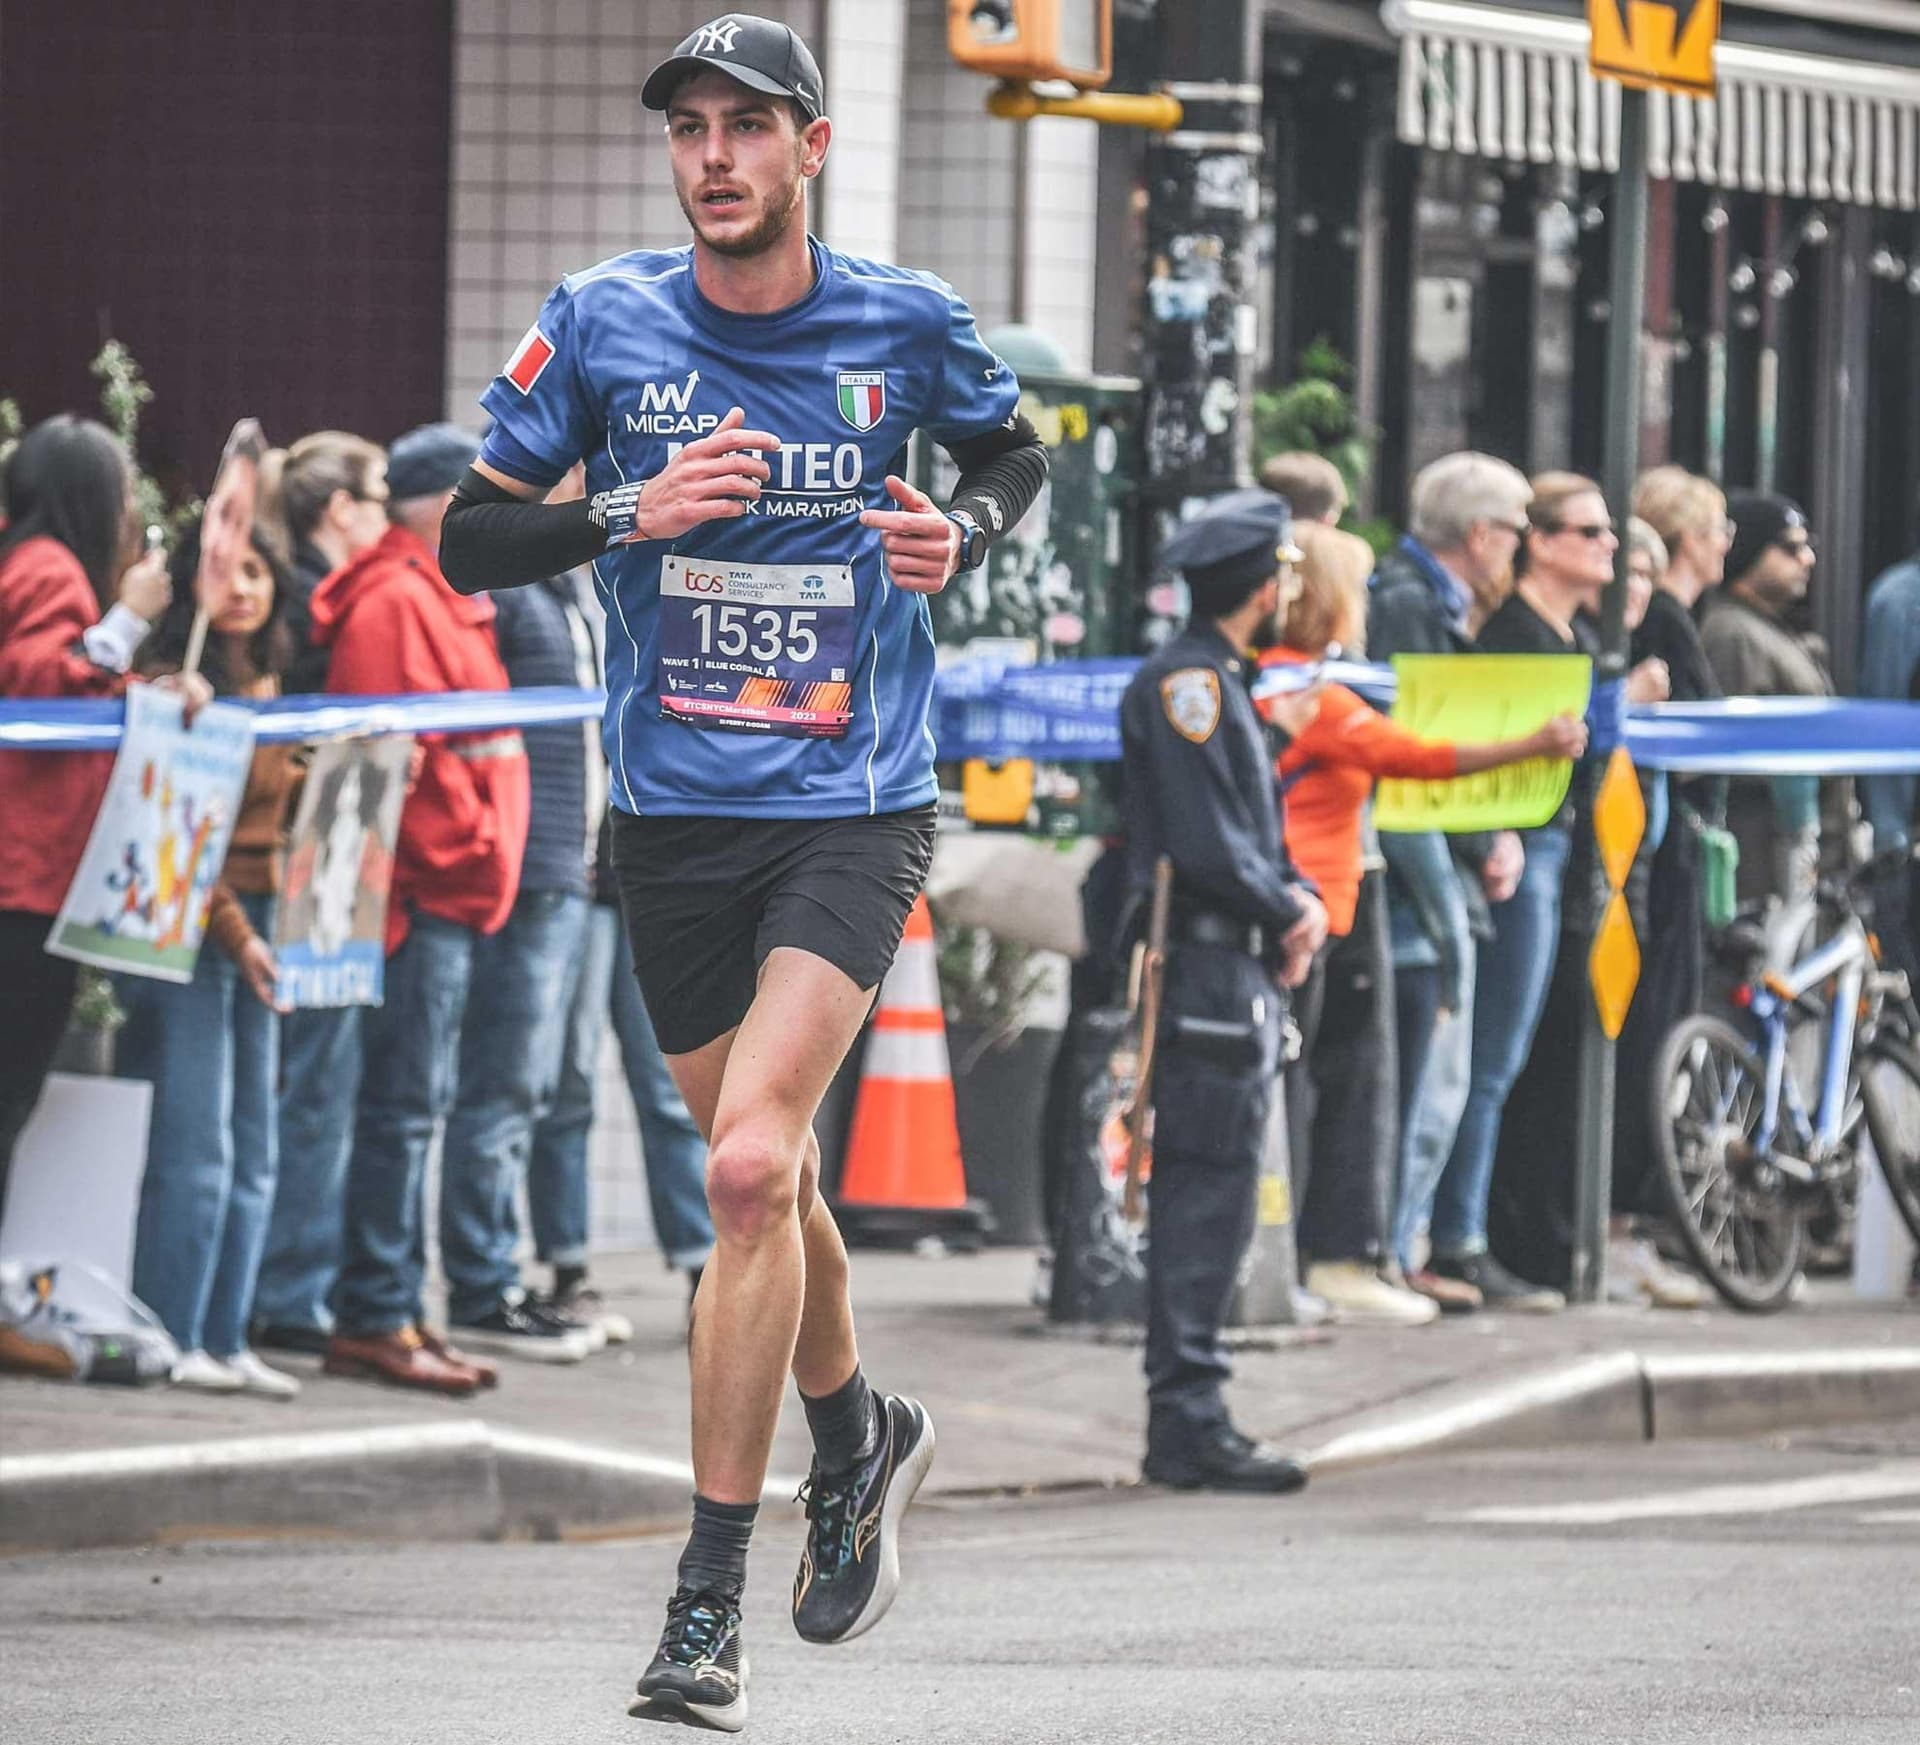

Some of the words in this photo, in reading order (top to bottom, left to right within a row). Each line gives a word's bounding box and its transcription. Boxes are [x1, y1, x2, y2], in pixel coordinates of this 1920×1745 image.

[844, 376, 874, 384] ITALIA
[766, 496, 865, 518] MARATHON
[685, 568, 723, 594] tcs
[728, 572, 753, 580] TATA
[728, 580, 786, 591] CONSULTANCY
[728, 588, 764, 599] SERVICES
[799, 592, 826, 600] TATA
[692, 604, 818, 663] 1535
[662, 657, 689, 668] WAVE
[692, 658, 700, 670] 1
[705, 660, 728, 671] BLUE
[730, 663, 764, 676] CORRAL
[765, 665, 777, 678] A
[790, 711, 817, 721] 2023
